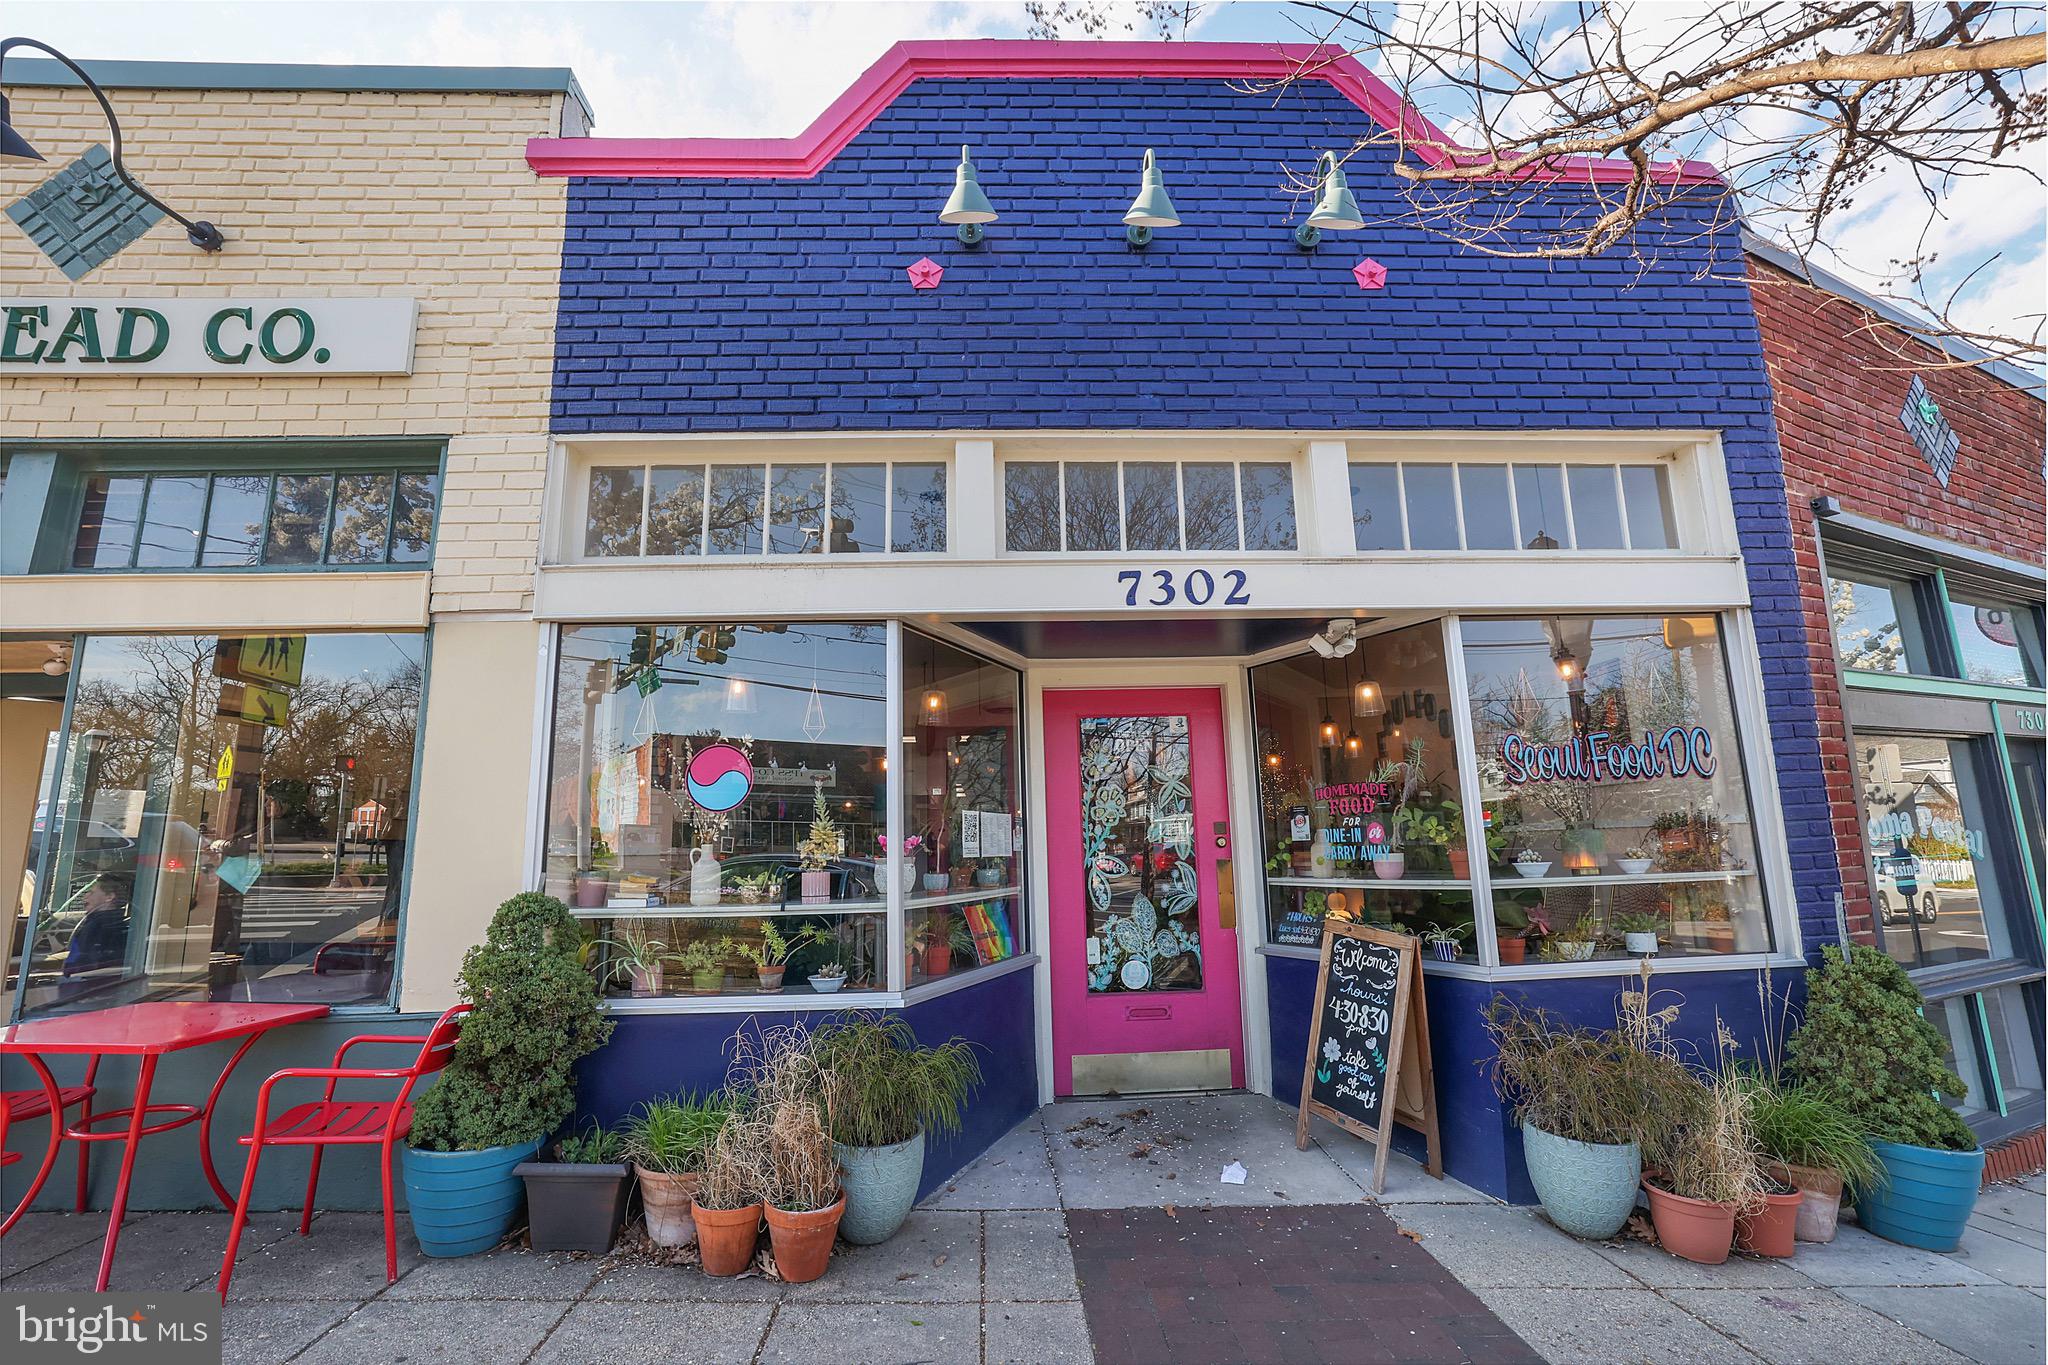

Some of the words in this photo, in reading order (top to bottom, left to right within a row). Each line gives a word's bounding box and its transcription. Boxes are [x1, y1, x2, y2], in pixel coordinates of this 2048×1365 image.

[1, 305, 170, 364] EAD
[203, 306, 331, 364] CO.
[1118, 569, 1250, 606] 7302
[2015, 708, 2046, 731] 730
[1503, 733, 1590, 786] Seoul
[1585, 730, 1664, 781] Food
[1658, 725, 1717, 780] DC
[1315, 783, 1388, 800] HOMEMADE
[1328, 797, 1376, 815] FOOD
[1342, 817, 1360, 826] FOR
[1324, 828, 1362, 842] DINE-IN
[1324, 845, 1357, 860] CARRY
[1360, 845, 1391, 861] AWAY
[1341, 948, 1391, 974] Welcome
[1345, 1024, 1367, 1038] pm
[1341, 1048, 1370, 1070] take
[1338, 1063, 1360, 1077] good
[1347, 1077, 1360, 1089] of
[1336, 1083, 1377, 1109] yourself
